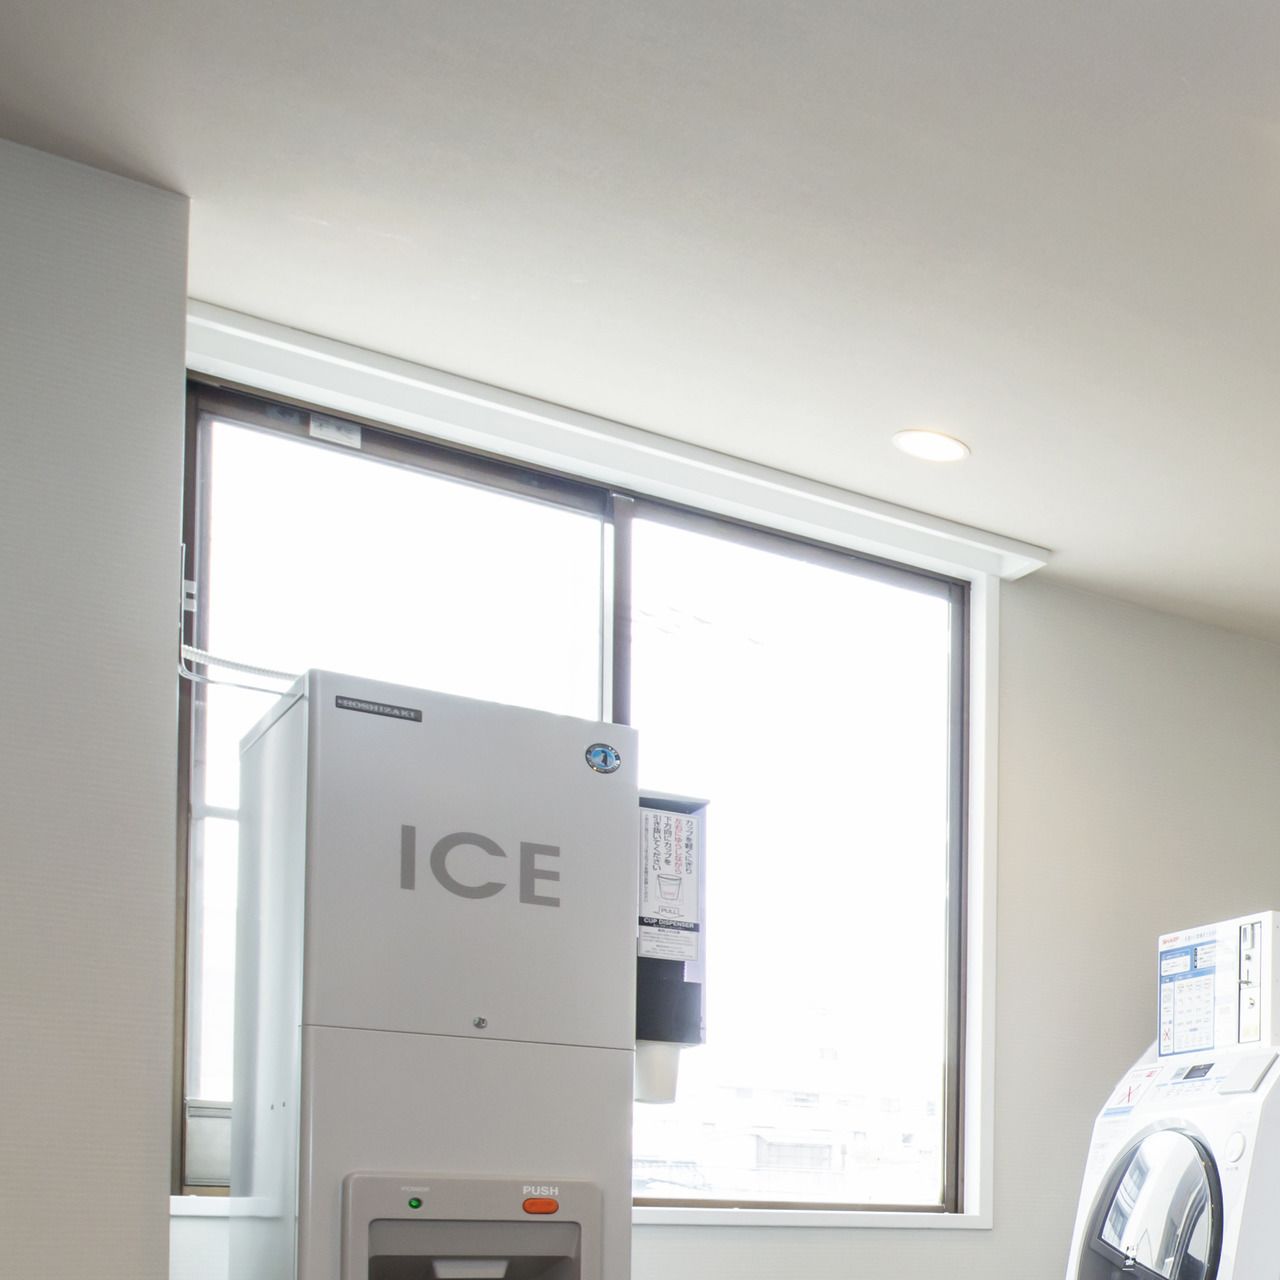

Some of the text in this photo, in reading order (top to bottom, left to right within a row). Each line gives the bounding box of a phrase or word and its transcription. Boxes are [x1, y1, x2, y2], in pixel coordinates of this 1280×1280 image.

[344, 699, 417, 719] HOSHIZAKI
[400, 823, 561, 908] ICE
[658, 918, 695, 929] DISPENSER
[522, 1185, 560, 1195] PUSH
